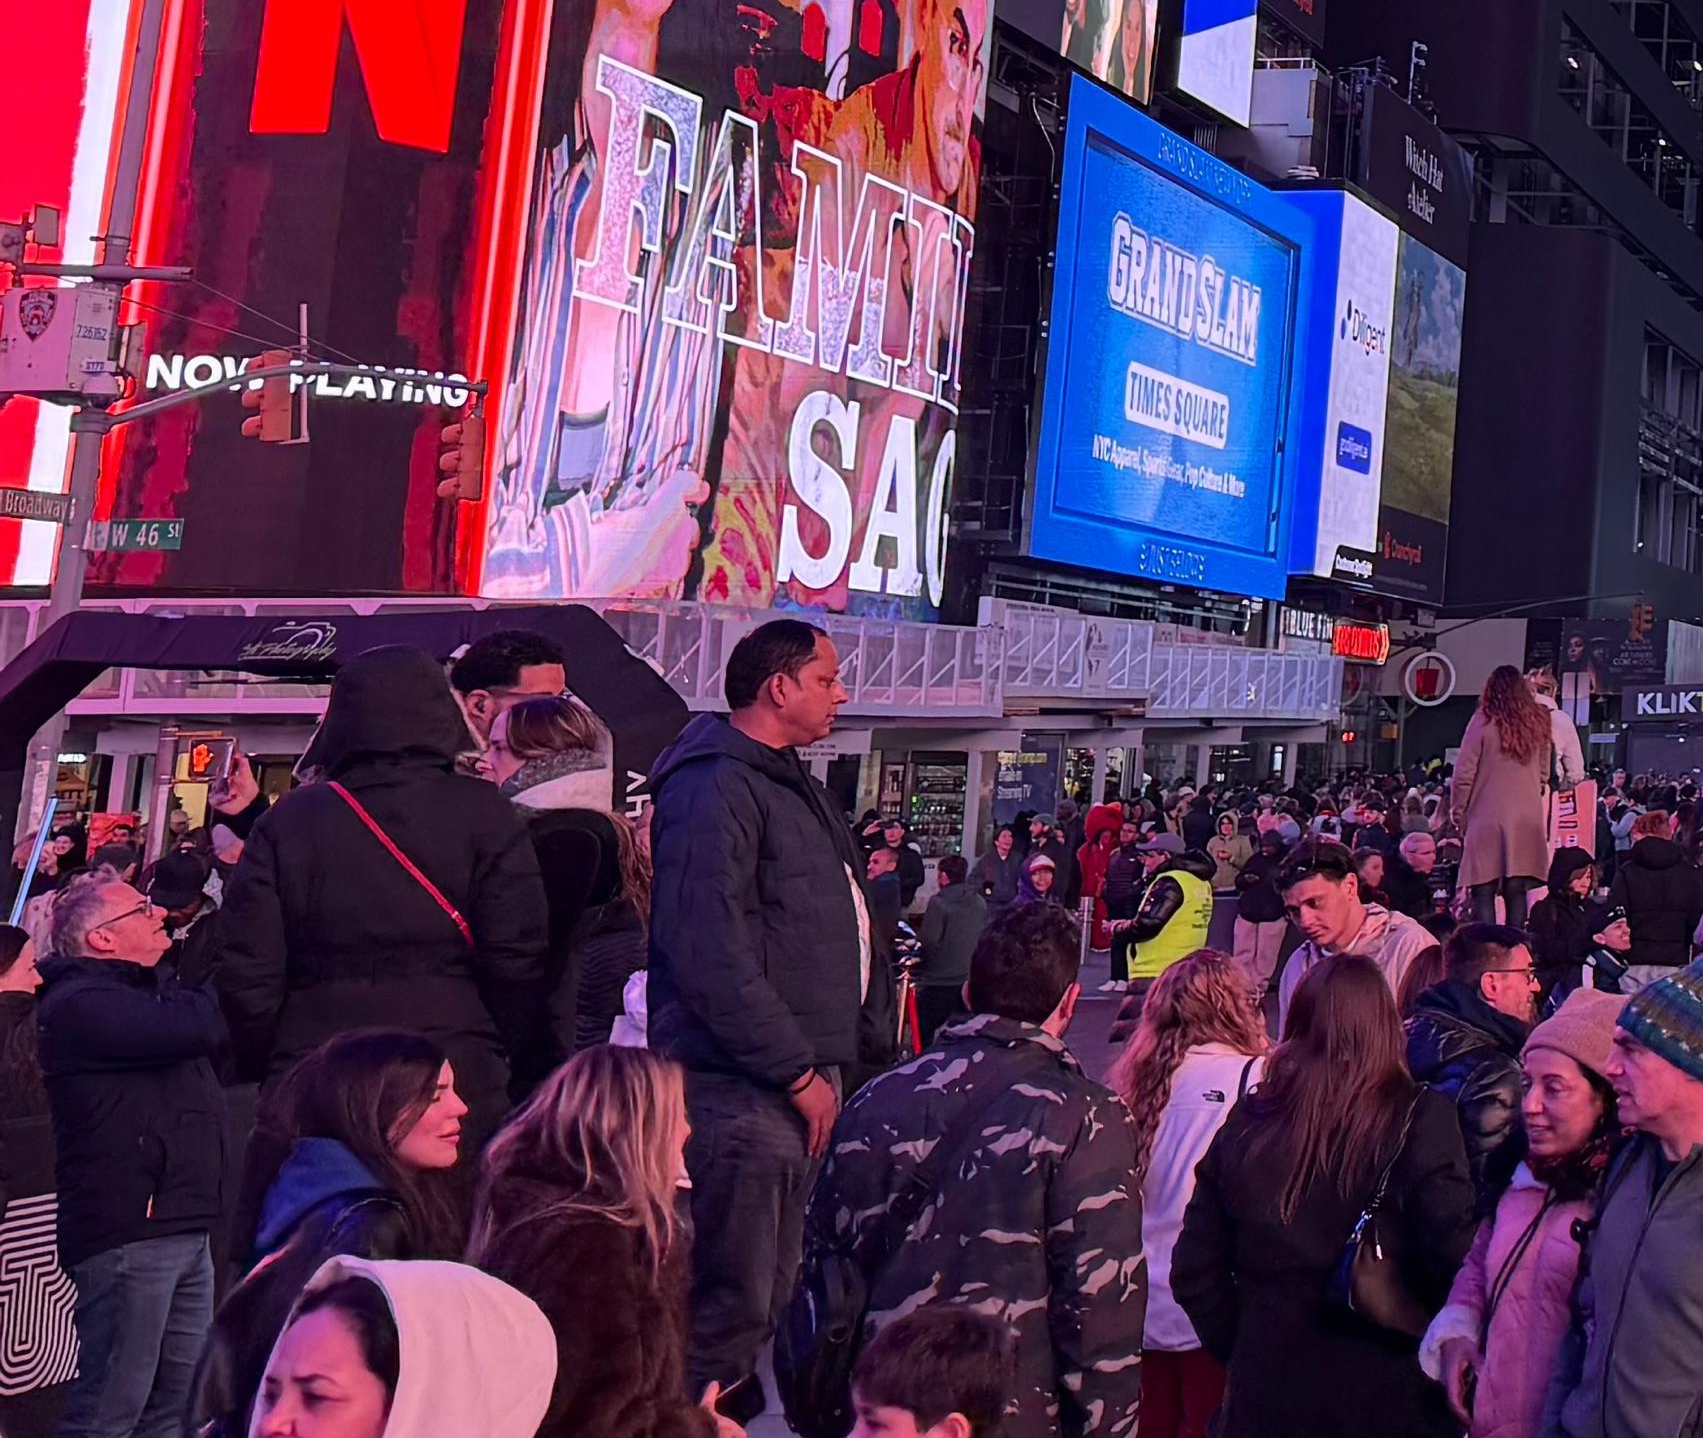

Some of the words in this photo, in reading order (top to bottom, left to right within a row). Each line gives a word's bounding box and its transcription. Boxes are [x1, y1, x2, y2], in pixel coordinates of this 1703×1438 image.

[1404, 135, 1426, 183] Witch
[1426, 155, 1444, 194] Hat
[1108, 211, 1197, 340] GRAND
[1195, 256, 1260, 366] SLAM
[1129, 370, 1171, 428] TIMES
[1174, 387, 1228, 441] SQUARE
[1092, 434, 1111, 462] NYC
[5, 492, 68, 522] Broadway
[111, 523, 129, 545] W
[136, 524, 160, 546] 46
